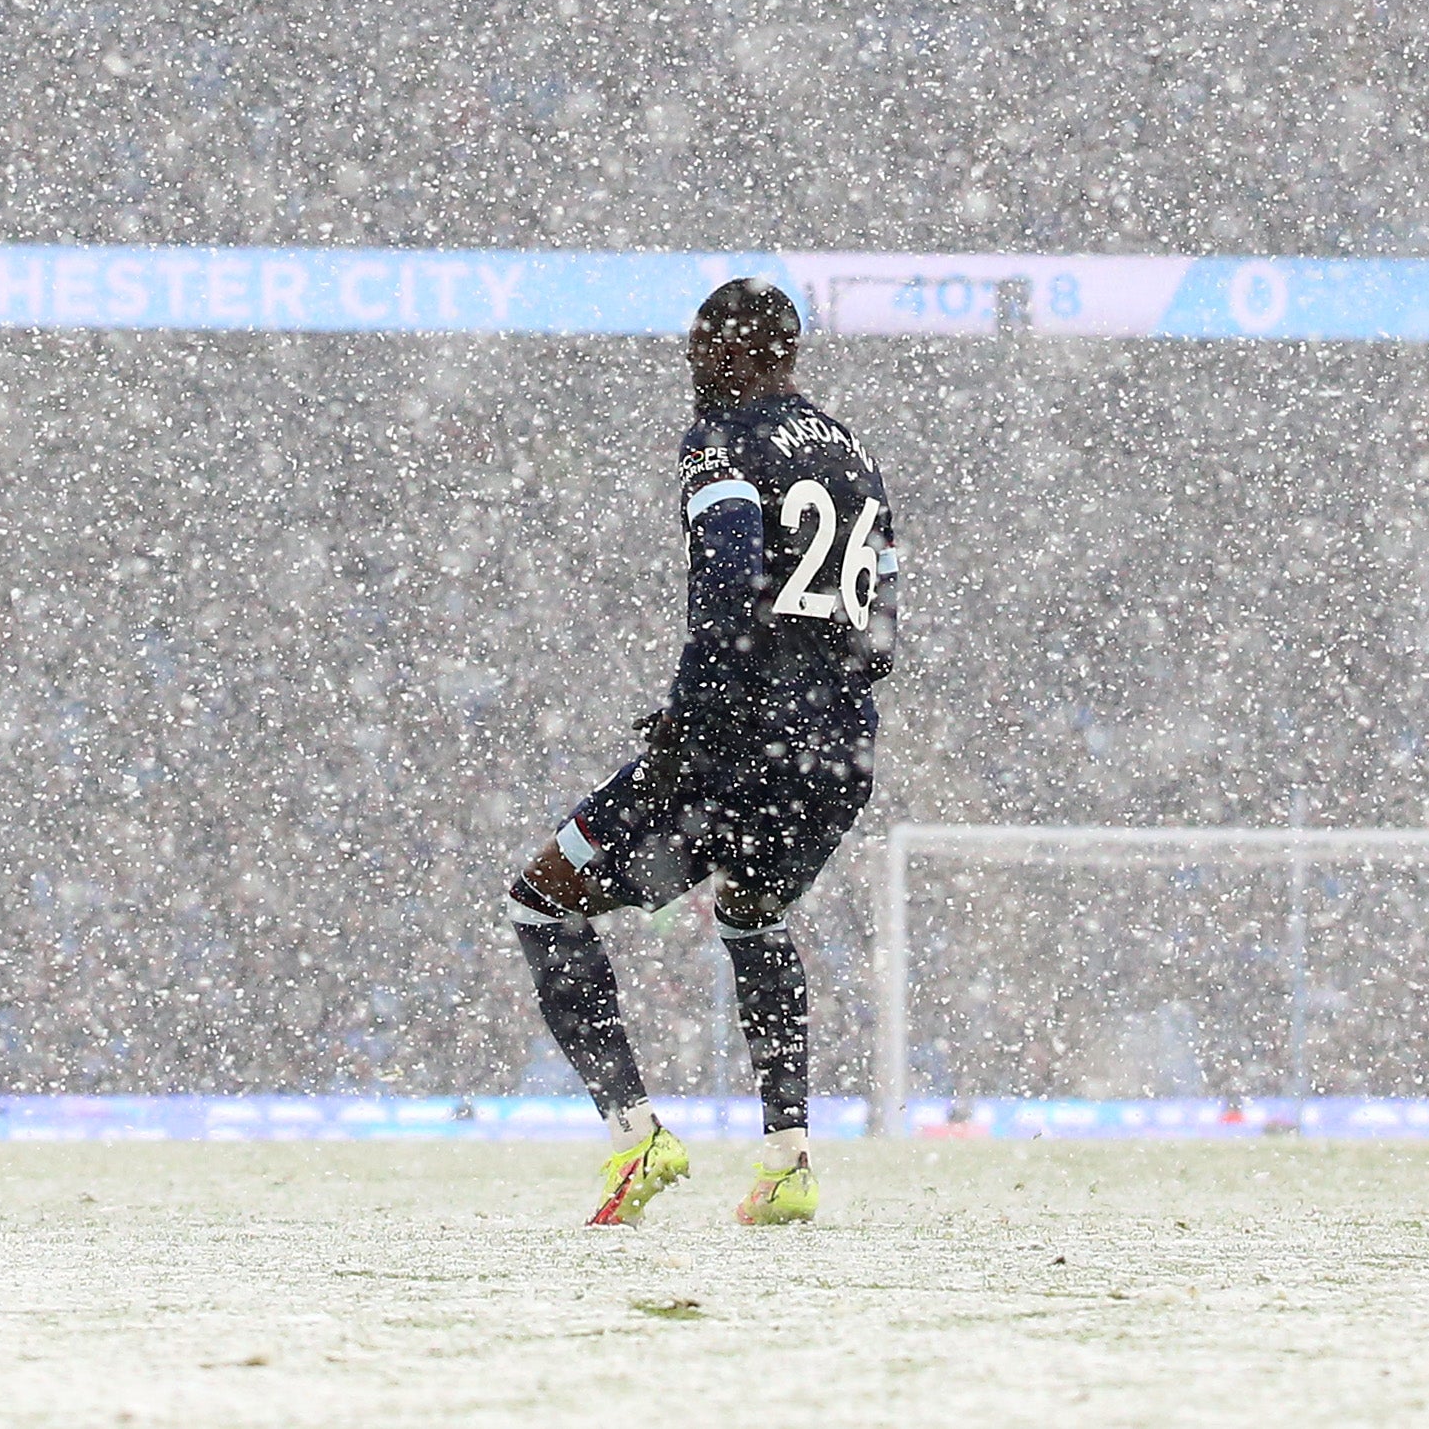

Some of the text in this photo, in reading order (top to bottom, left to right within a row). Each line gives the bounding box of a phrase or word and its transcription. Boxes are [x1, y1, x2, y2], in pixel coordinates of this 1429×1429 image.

[339, 259, 527, 319] CITY
[892, 273, 1084, 321] 40:8
[1229, 263, 1289, 334] 0
[772, 478, 880, 631] 26
